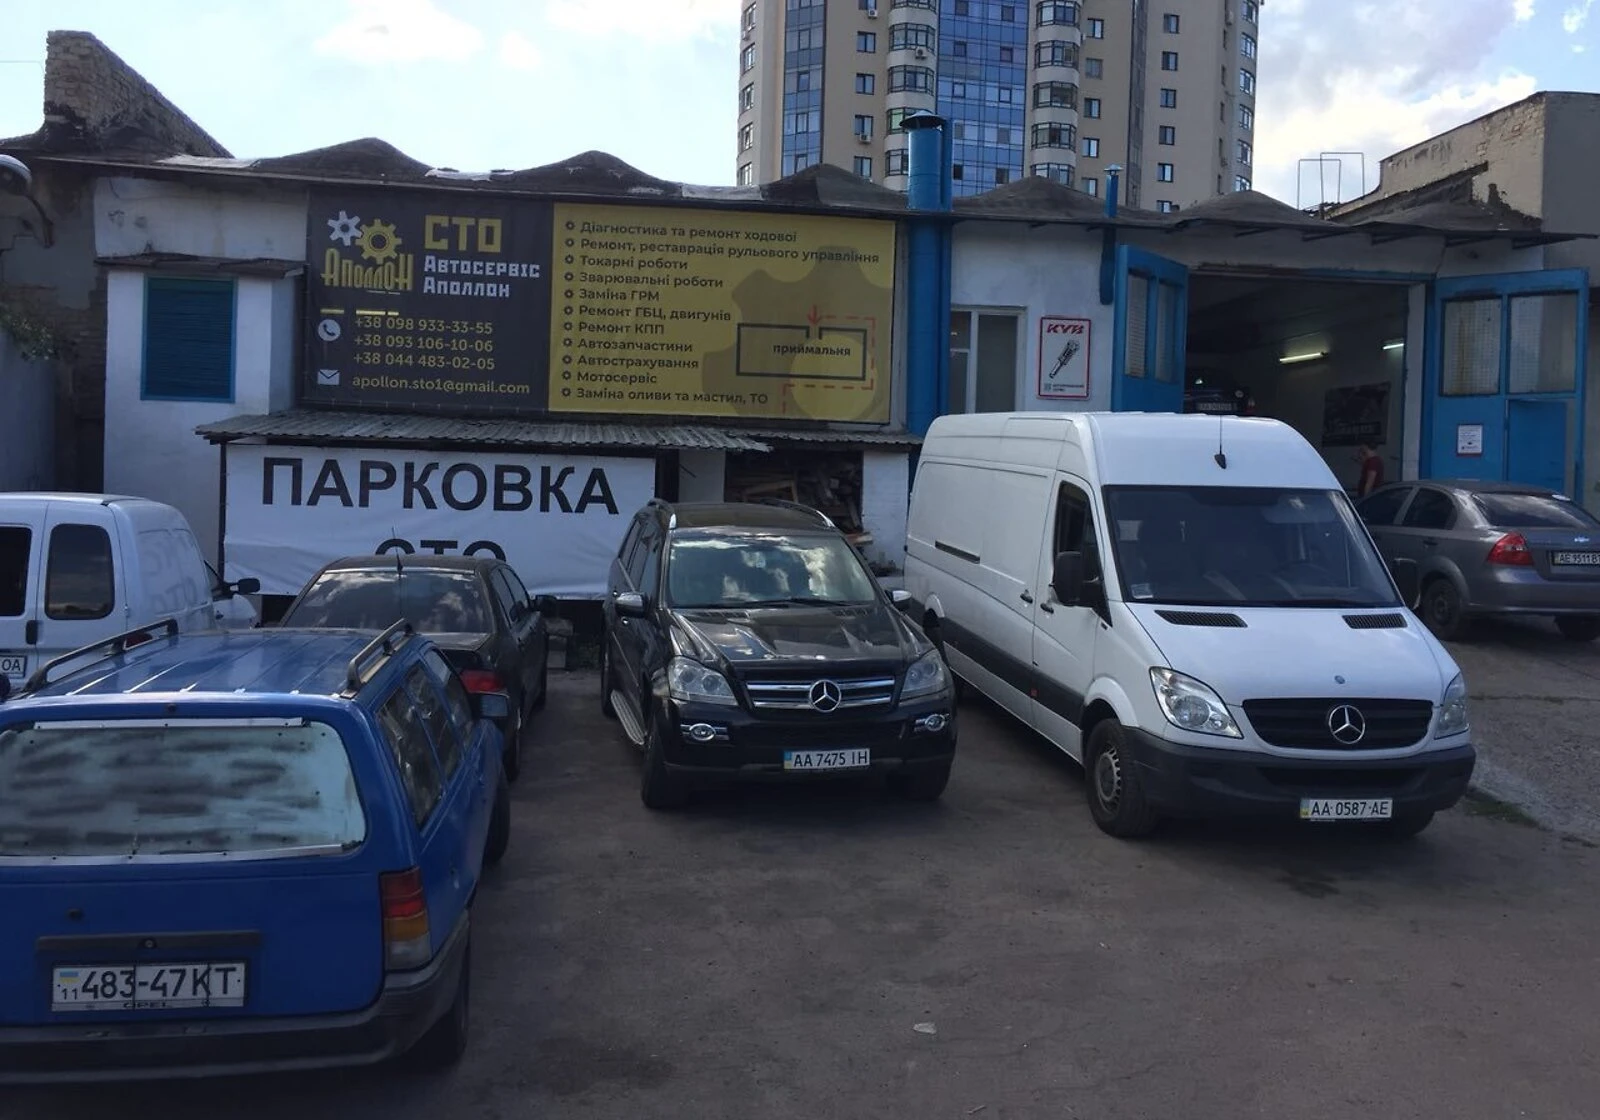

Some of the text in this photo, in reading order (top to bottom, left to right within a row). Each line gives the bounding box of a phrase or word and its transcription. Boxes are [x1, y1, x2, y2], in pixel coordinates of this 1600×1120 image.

[424, 214, 502, 253] СТО
[580, 221, 667, 236] Діагностика
[671, 228, 686, 237] та
[689, 230, 741, 241] ремонт
[580, 238, 879, 264] Ремонт, реставрація рульового управління
[580, 254, 688, 270] Токарні роботи
[579, 272, 723, 287] Зварювальні роботи
[579, 288, 660, 301] Заміна ГРМ
[579, 304, 731, 323] Ремонт ГБЦ, двигунів
[355, 316, 493, 335] +38 098 933-33-55
[578, 321, 665, 335] Ремонт КПП
[354, 334, 493, 353] +38 093 106-10-06
[577, 338, 693, 352] Автозапчастини
[353, 352, 495, 371] +38 044 483-02-05
[577, 354, 699, 369] Автострахування
[352, 374, 530, 395] apollon.sto1@gmail.com
[577, 371, 657, 385] Мотосервіс
[576, 387, 624, 400] Заміна
[628, 390, 671, 401] оливи
[675, 392, 689, 402] та
[750, 393, 769, 404] ТО
[262, 456, 619, 515] ПАРКОВКА
[793, 751, 867, 767] AA 7475 IH
[1311, 801, 1389, 816] AA 0587 AE
